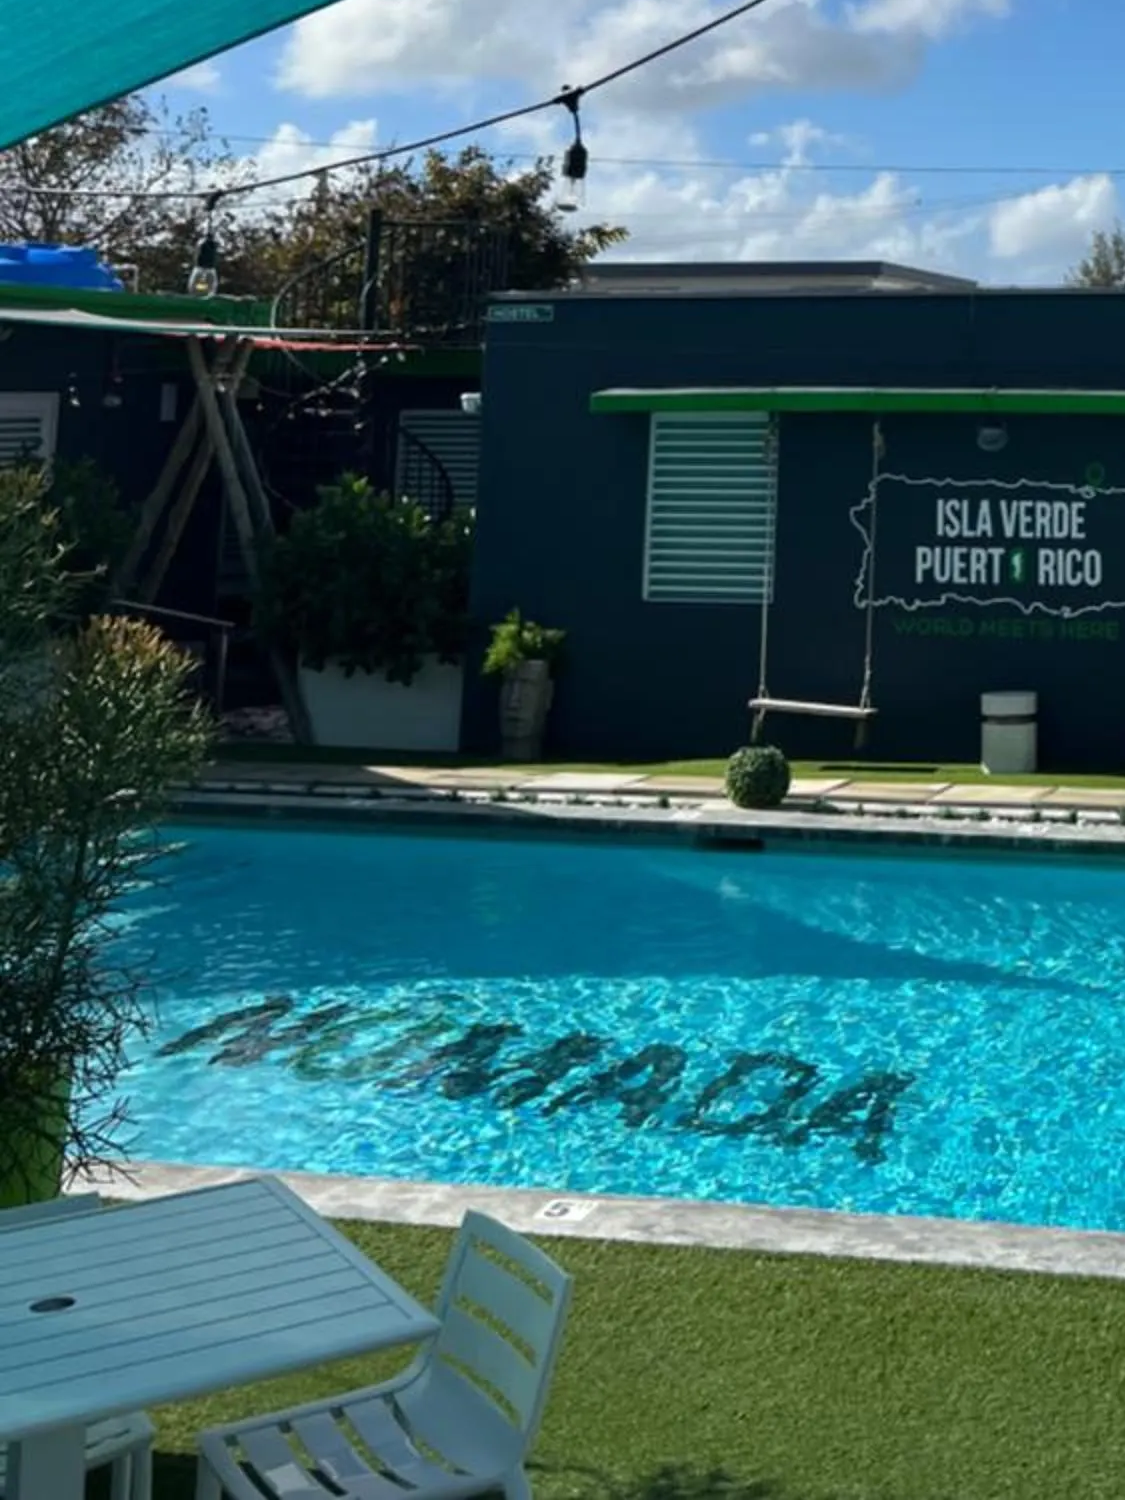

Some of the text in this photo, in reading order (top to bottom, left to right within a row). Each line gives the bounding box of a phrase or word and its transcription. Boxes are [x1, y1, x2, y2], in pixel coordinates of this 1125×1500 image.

[935, 498, 1087, 540] ISLA VERDE
[1037, 549, 1103, 587] RICO
